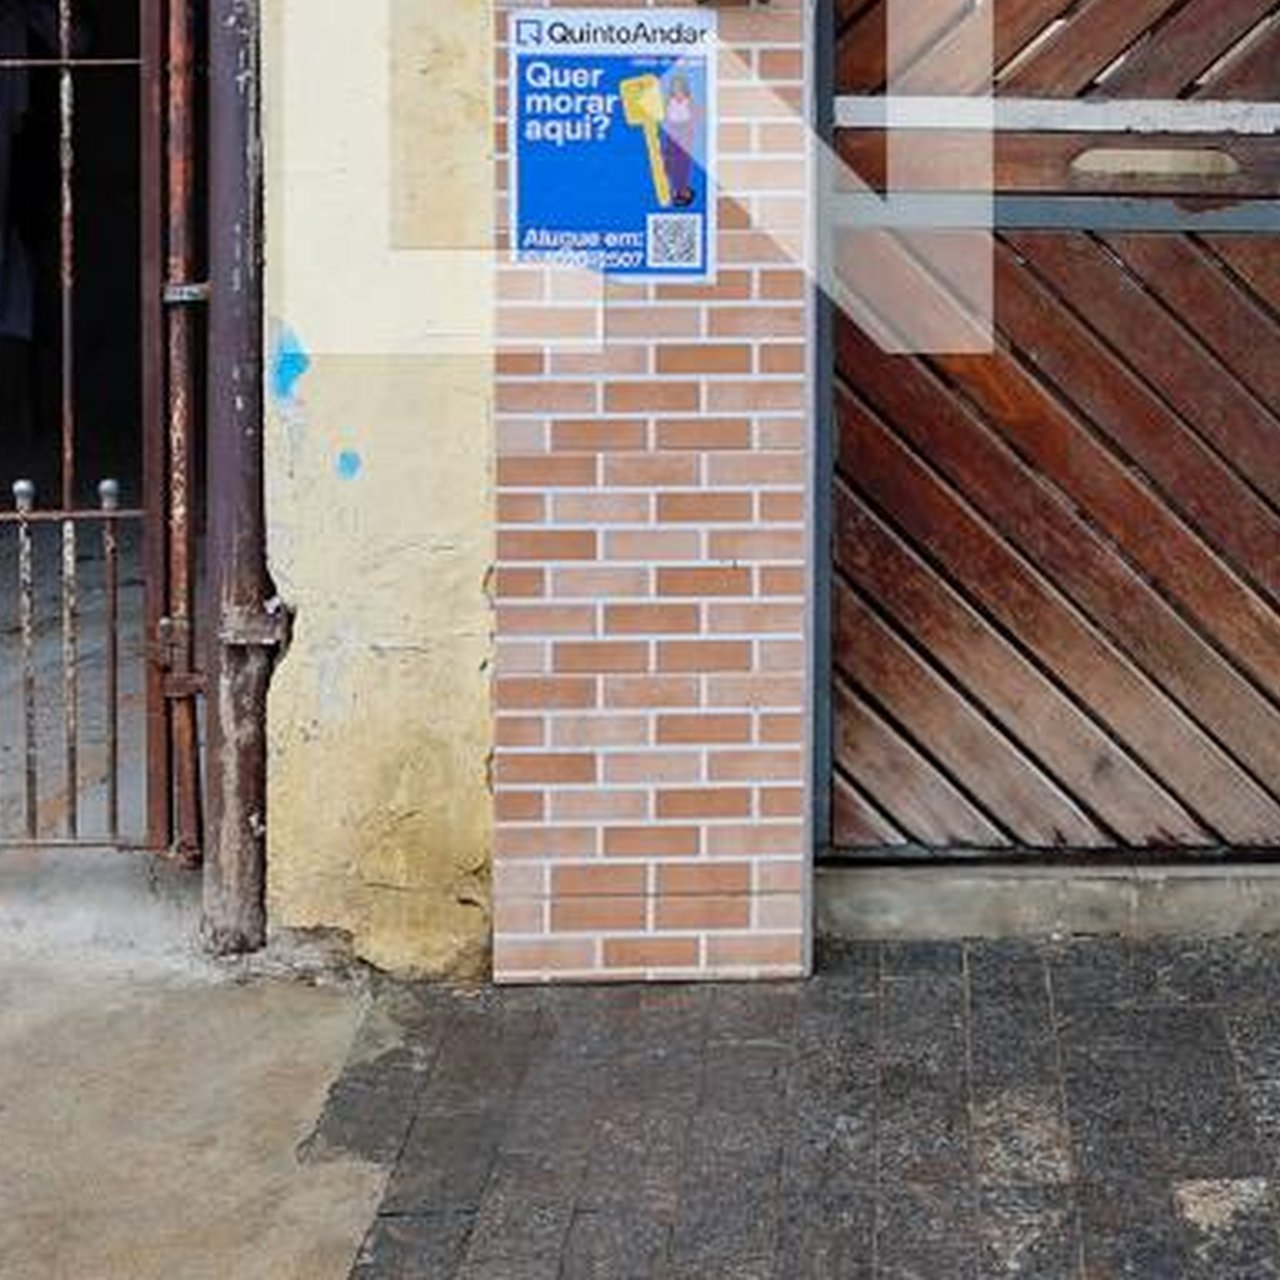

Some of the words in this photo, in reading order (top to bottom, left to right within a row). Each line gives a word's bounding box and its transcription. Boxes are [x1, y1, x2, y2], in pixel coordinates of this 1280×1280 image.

[547, 22, 708, 44] QuintoAndar
[526, 62, 604, 88] Quer
[525, 94, 618, 113] morar
[525, 116, 610, 145] aqui?
